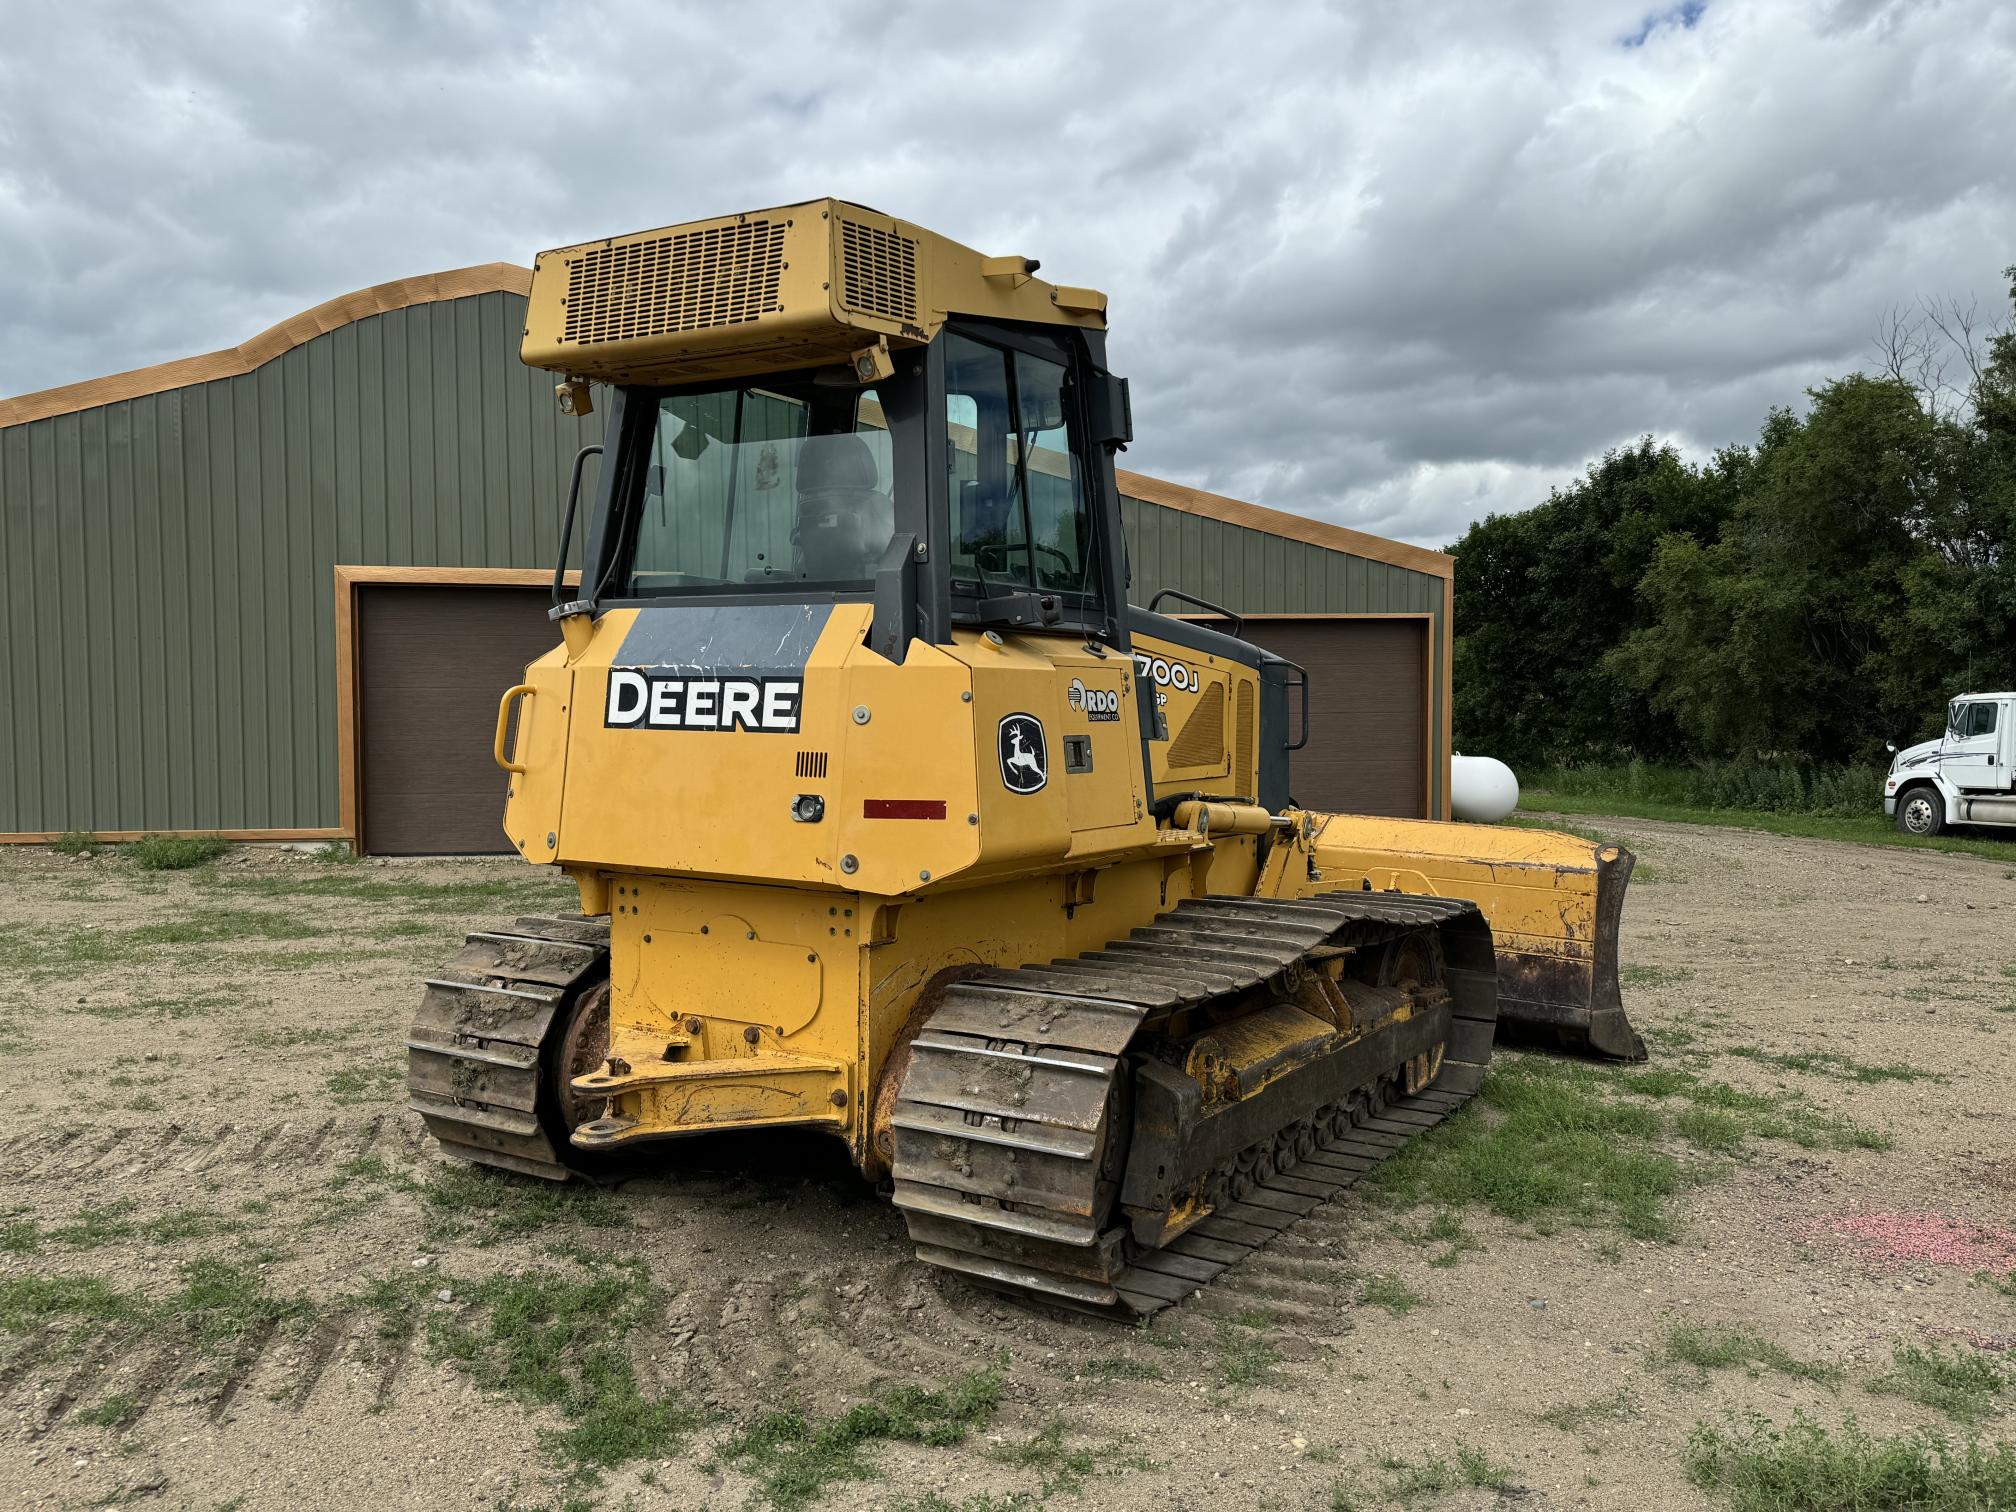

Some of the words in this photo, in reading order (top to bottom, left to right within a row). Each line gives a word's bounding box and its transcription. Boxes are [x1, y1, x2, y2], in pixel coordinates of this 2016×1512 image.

[1135, 653, 1200, 693] 700J
[606, 670, 801, 729] DEERE
[1086, 690, 1119, 712] RDO
